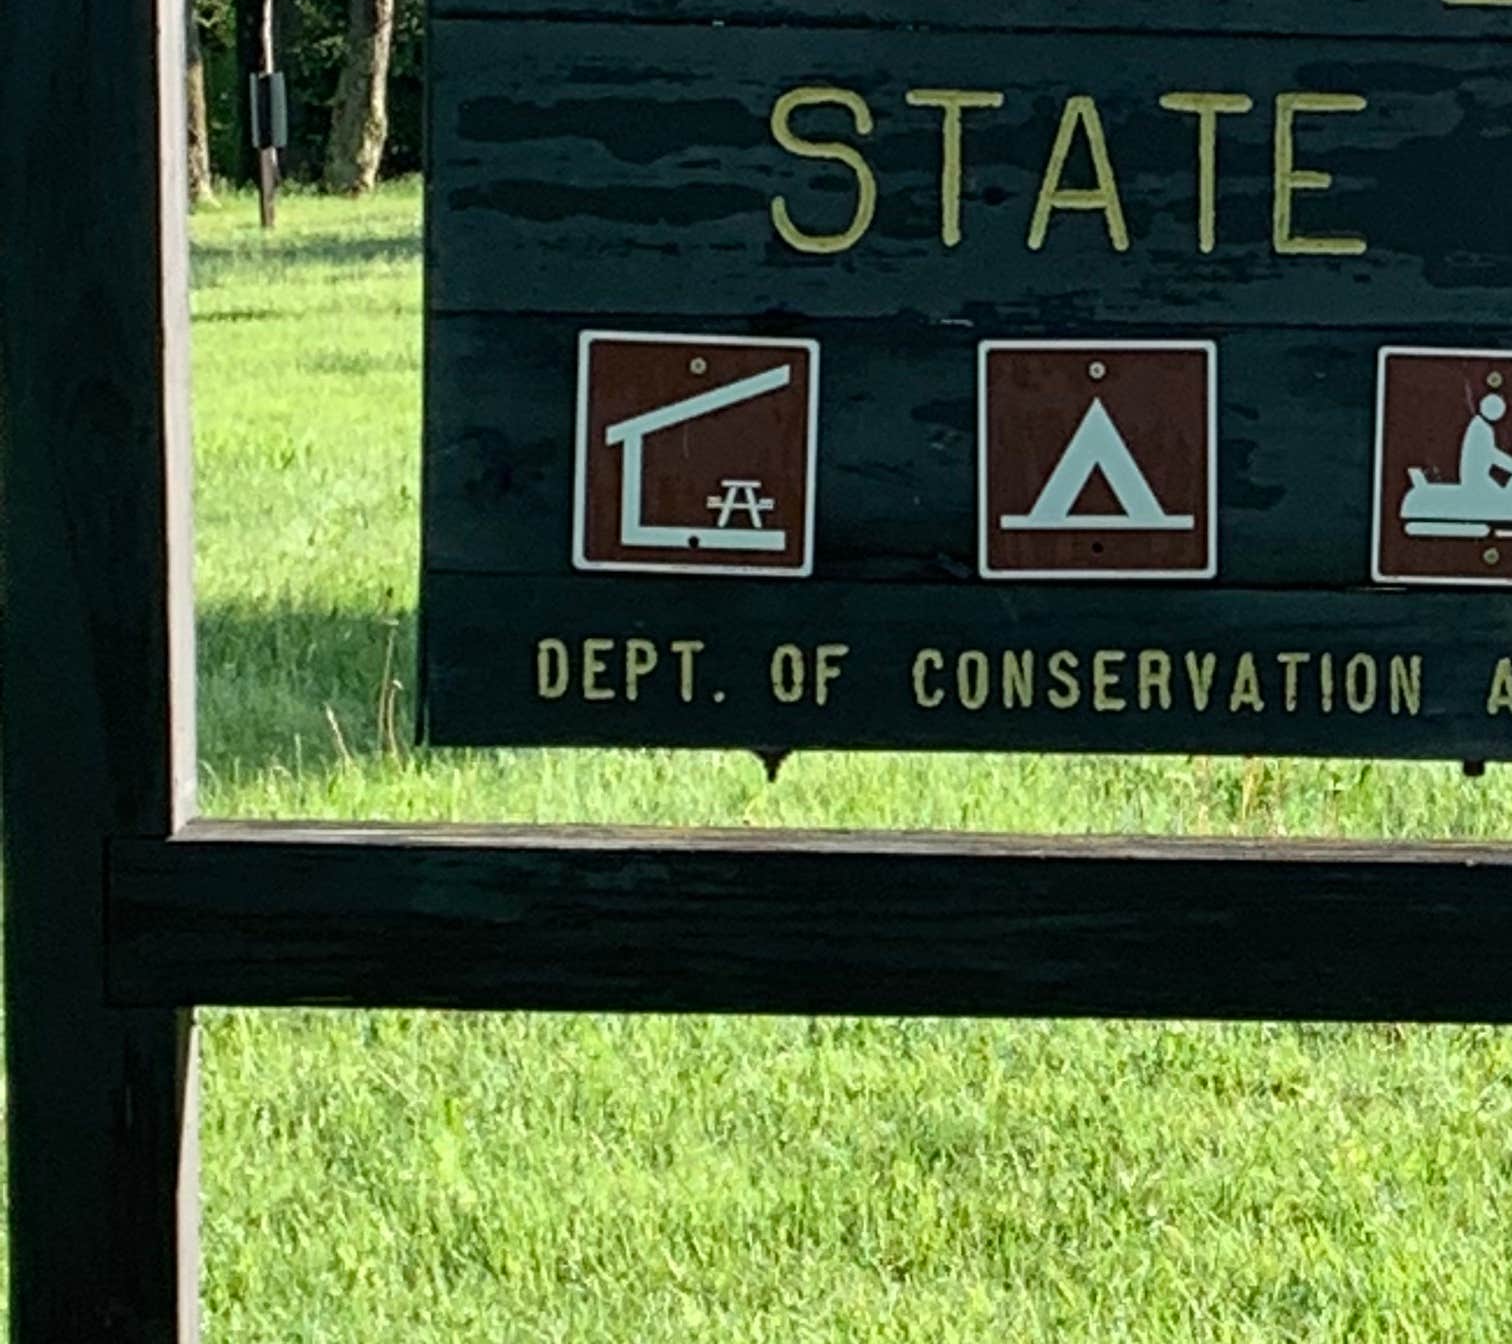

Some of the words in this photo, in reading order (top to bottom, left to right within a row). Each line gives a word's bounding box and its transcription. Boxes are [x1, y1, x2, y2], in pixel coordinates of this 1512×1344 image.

[770, 87, 1368, 256] STATE
[536, 637, 726, 703] DEPT.
[770, 644, 850, 706] OF
[911, 648, 1422, 716] CONSERVATION
